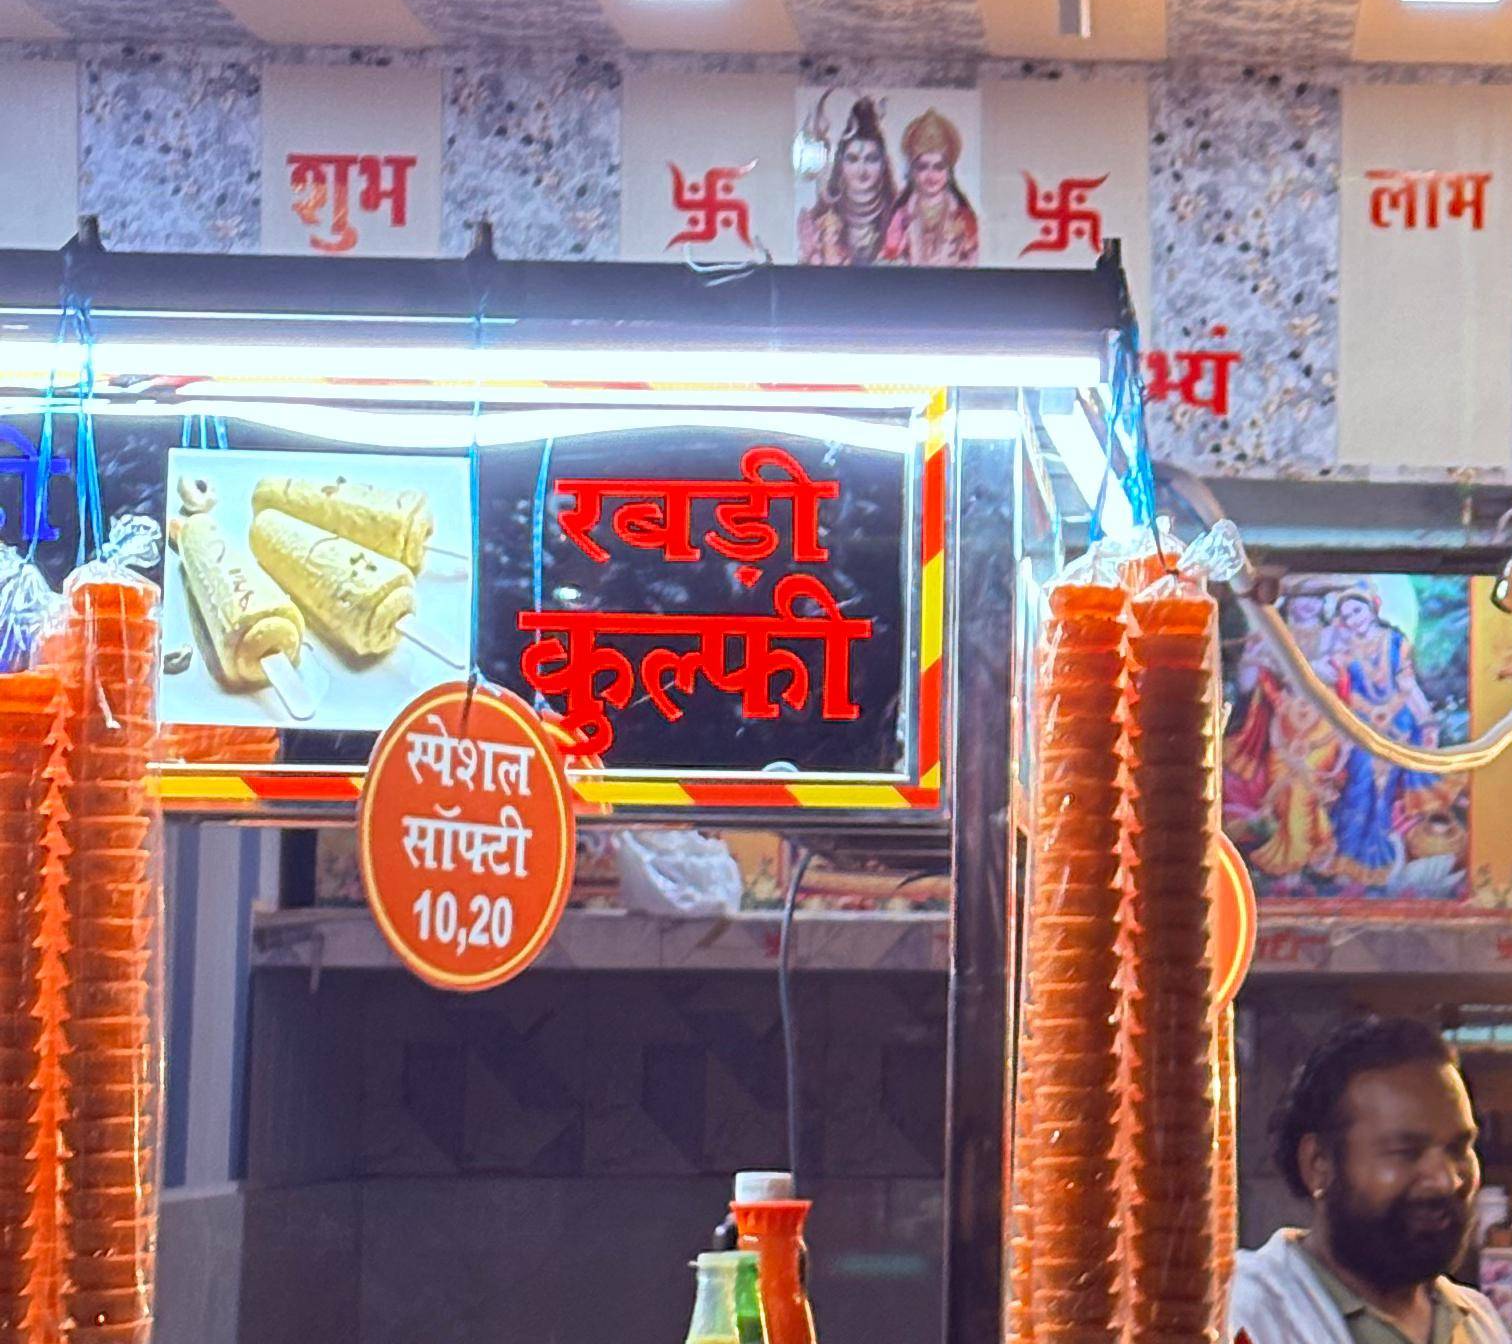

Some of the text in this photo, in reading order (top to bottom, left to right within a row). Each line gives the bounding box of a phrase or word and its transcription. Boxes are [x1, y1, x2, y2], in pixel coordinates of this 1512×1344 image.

[287, 154, 417, 251] शुभ
[554, 446, 840, 587] रबड़ी
[517, 573, 873, 756] कुल्फी
[405, 714, 536, 796] स्पेशल
[402, 803, 533, 878] सॉफ्टी
[412, 889, 513, 957] 10,20
